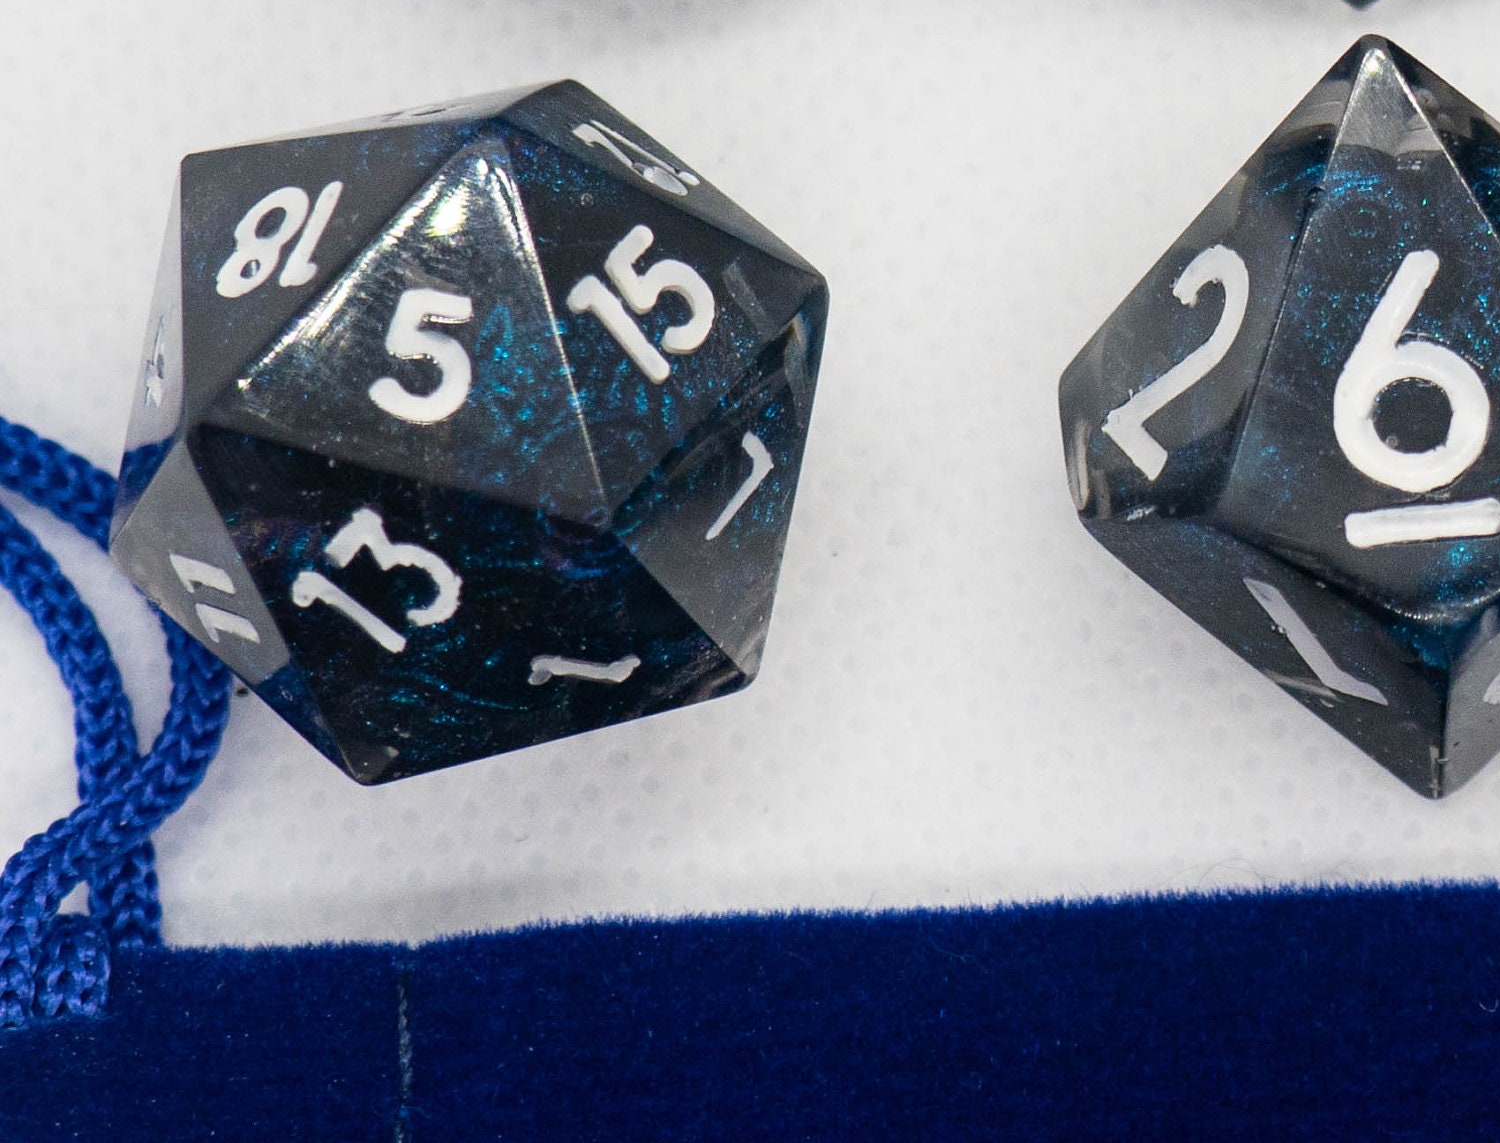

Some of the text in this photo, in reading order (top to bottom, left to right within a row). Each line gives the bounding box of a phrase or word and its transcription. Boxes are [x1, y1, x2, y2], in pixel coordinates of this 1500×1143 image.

[216, 181, 343, 298] 18
[567, 225, 715, 385] 15
[369, 289, 472, 424] 5
[1102, 244, 1249, 481] 2
[1334, 250, 1490, 501] 6
[292, 508, 463, 653] 13
